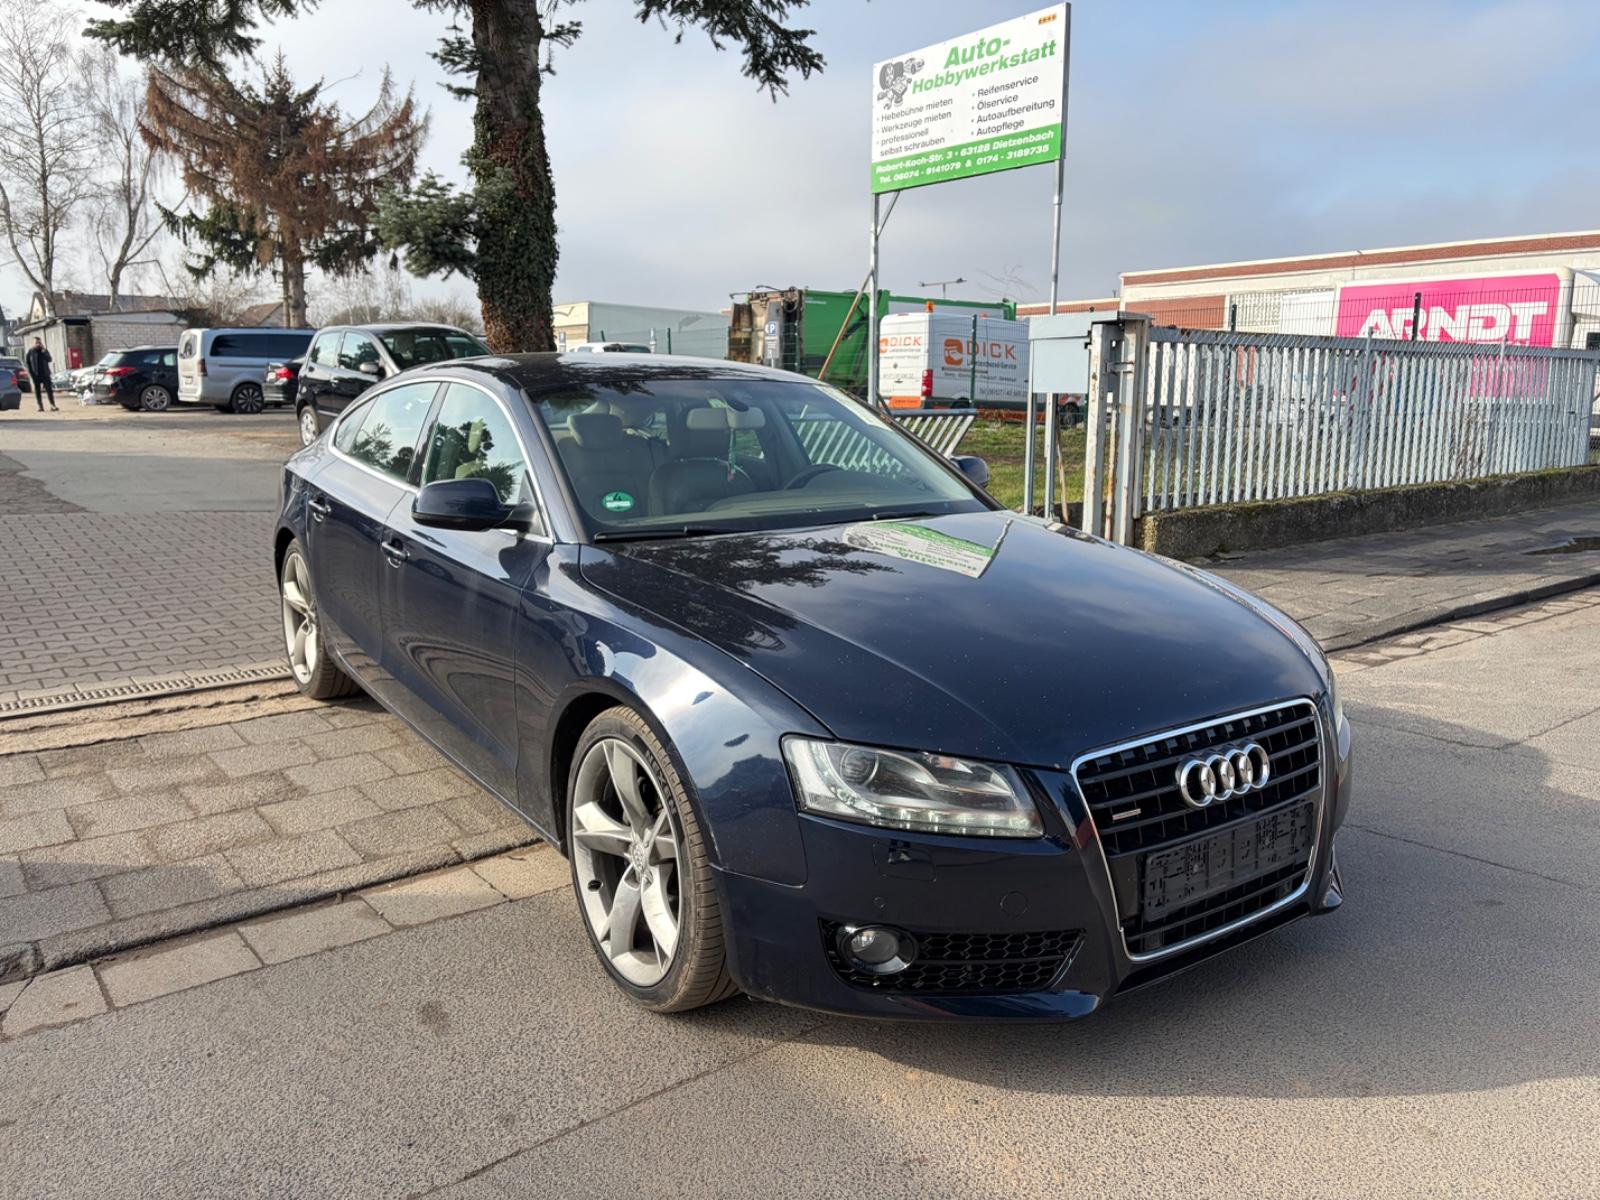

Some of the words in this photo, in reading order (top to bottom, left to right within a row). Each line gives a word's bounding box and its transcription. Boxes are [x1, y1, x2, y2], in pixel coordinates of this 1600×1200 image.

[944, 37, 1011, 69] Auto-
[912, 39, 1057, 94] Hobbywerkstatt
[977, 75, 1039, 97] Reifenservice
[881, 105, 924, 121] Hebebühne
[925, 98, 953, 110] mieten
[976, 94, 1018, 110] Ölservice
[976, 99, 1055, 124] Autoaufbereitung
[881, 118, 923, 134] Werkzeuge
[924, 111, 952, 123] mieten
[976, 119, 1025, 136] Autopflege
[880, 128, 929, 146] professionell
[880, 146, 903, 157] selbst
[904, 136, 945, 151] schrauben
[946, 151, 953, 159] 3
[992, 130, 1055, 149] Dietzenbach
[976, 154, 999, 165] 0174
[1356, 301, 1548, 342] ARNDT
[890, 336, 922, 347] DICK
[966, 340, 1017, 360] DICK
